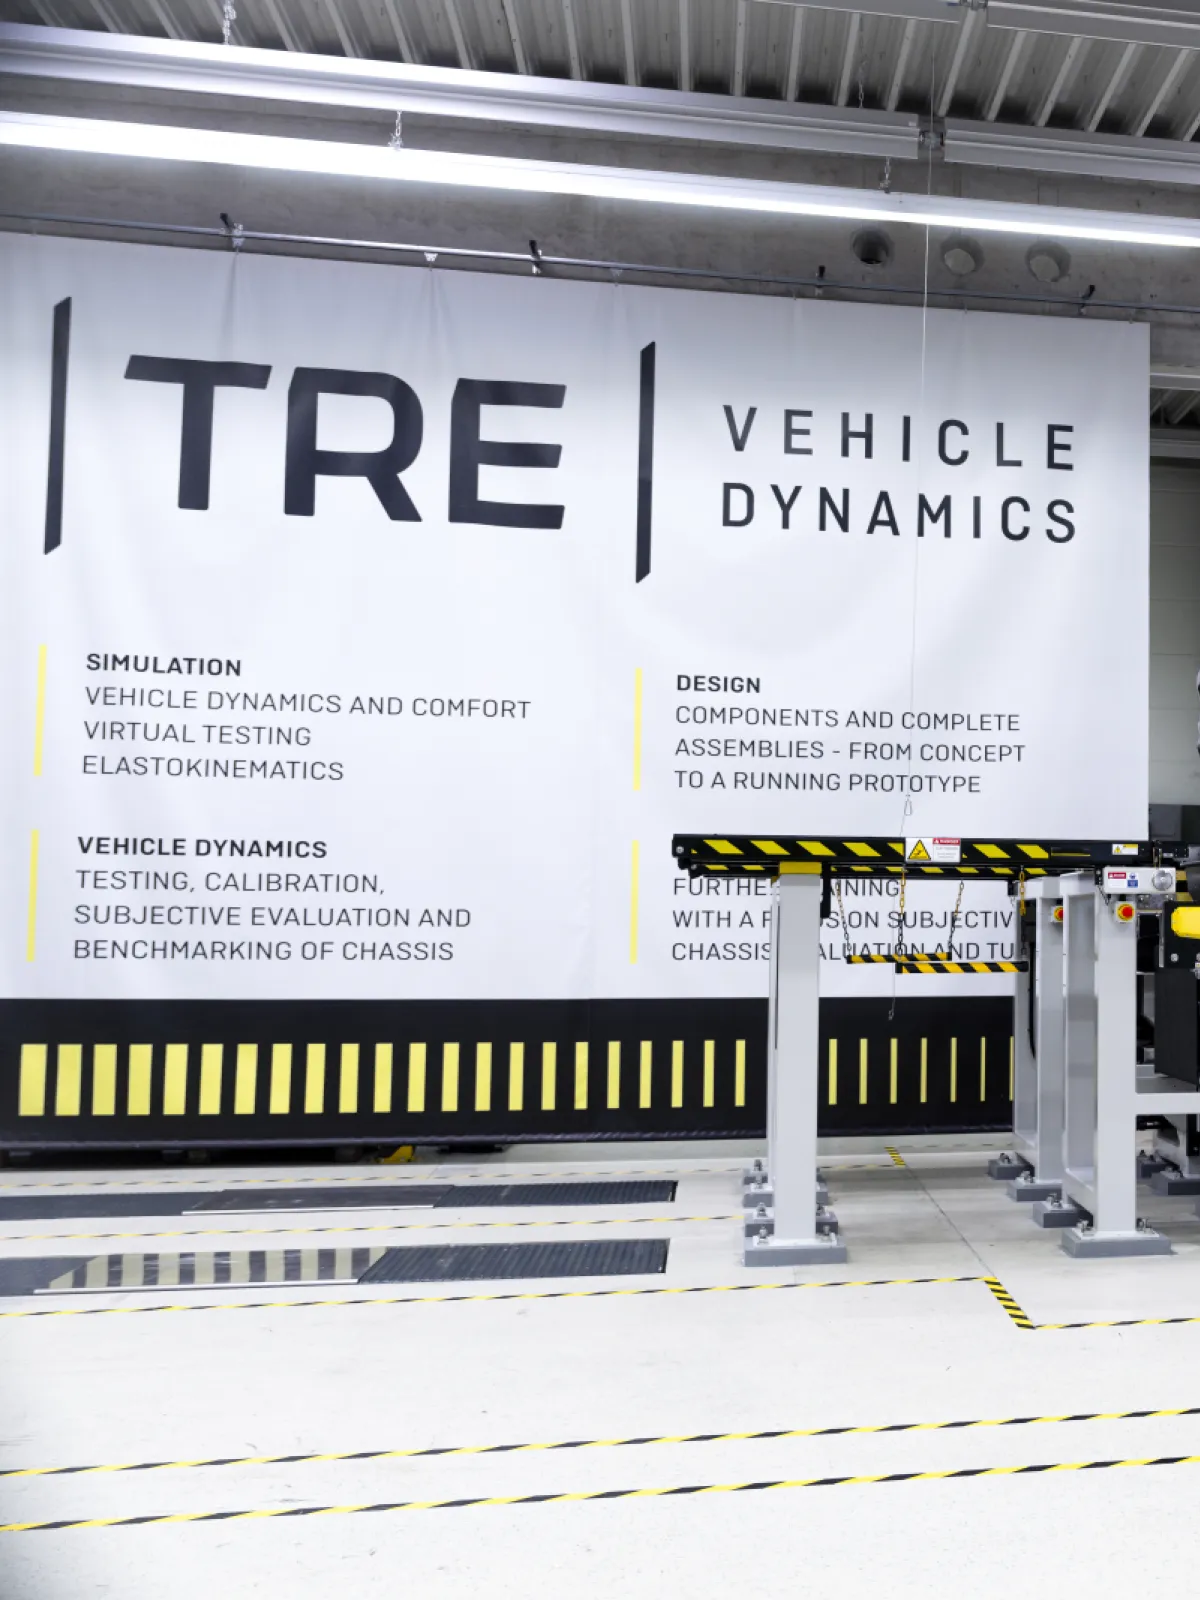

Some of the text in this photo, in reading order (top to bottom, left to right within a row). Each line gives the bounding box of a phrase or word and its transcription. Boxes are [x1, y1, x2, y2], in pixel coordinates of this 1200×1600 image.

[123, 353, 568, 530] TRE
[722, 404, 1075, 472] VEHICLE
[722, 482, 1076, 544] DYNAMICS
[86, 653, 241, 677] SIMULATION
[677, 674, 761, 694] DESIGN
[85, 686, 532, 719] VEHICLE DYNAMICS AND COMFORT
[675, 705, 1020, 731] COMPONENTS AND COMPLETE
[83, 720, 311, 746] VIRTUAL TESTING
[675, 738, 824, 759] ASSEMBLIES
[849, 741, 911, 761] FROM
[920, 743, 1025, 763] CONCEPT
[83, 755, 344, 781] ELASTOKINEMATICS
[674, 770, 980, 793] TO A RUNNING PROTOTYPE
[77, 836, 327, 859] VEHICLE DYNAMICS
[76, 869, 384, 895] TESTING, CALIBRATION,
[673, 878, 778, 896] FURTHE
[74, 904, 471, 928] SUBJECTIVE EVALUATION AND
[672, 910, 731, 928] WITH
[739, 910, 754, 928] A
[848, 910, 879, 929] ON
[887, 911, 1013, 929] SUBJECTIV
[74, 939, 454, 961] BENCHMARKING OF CHASSIS
